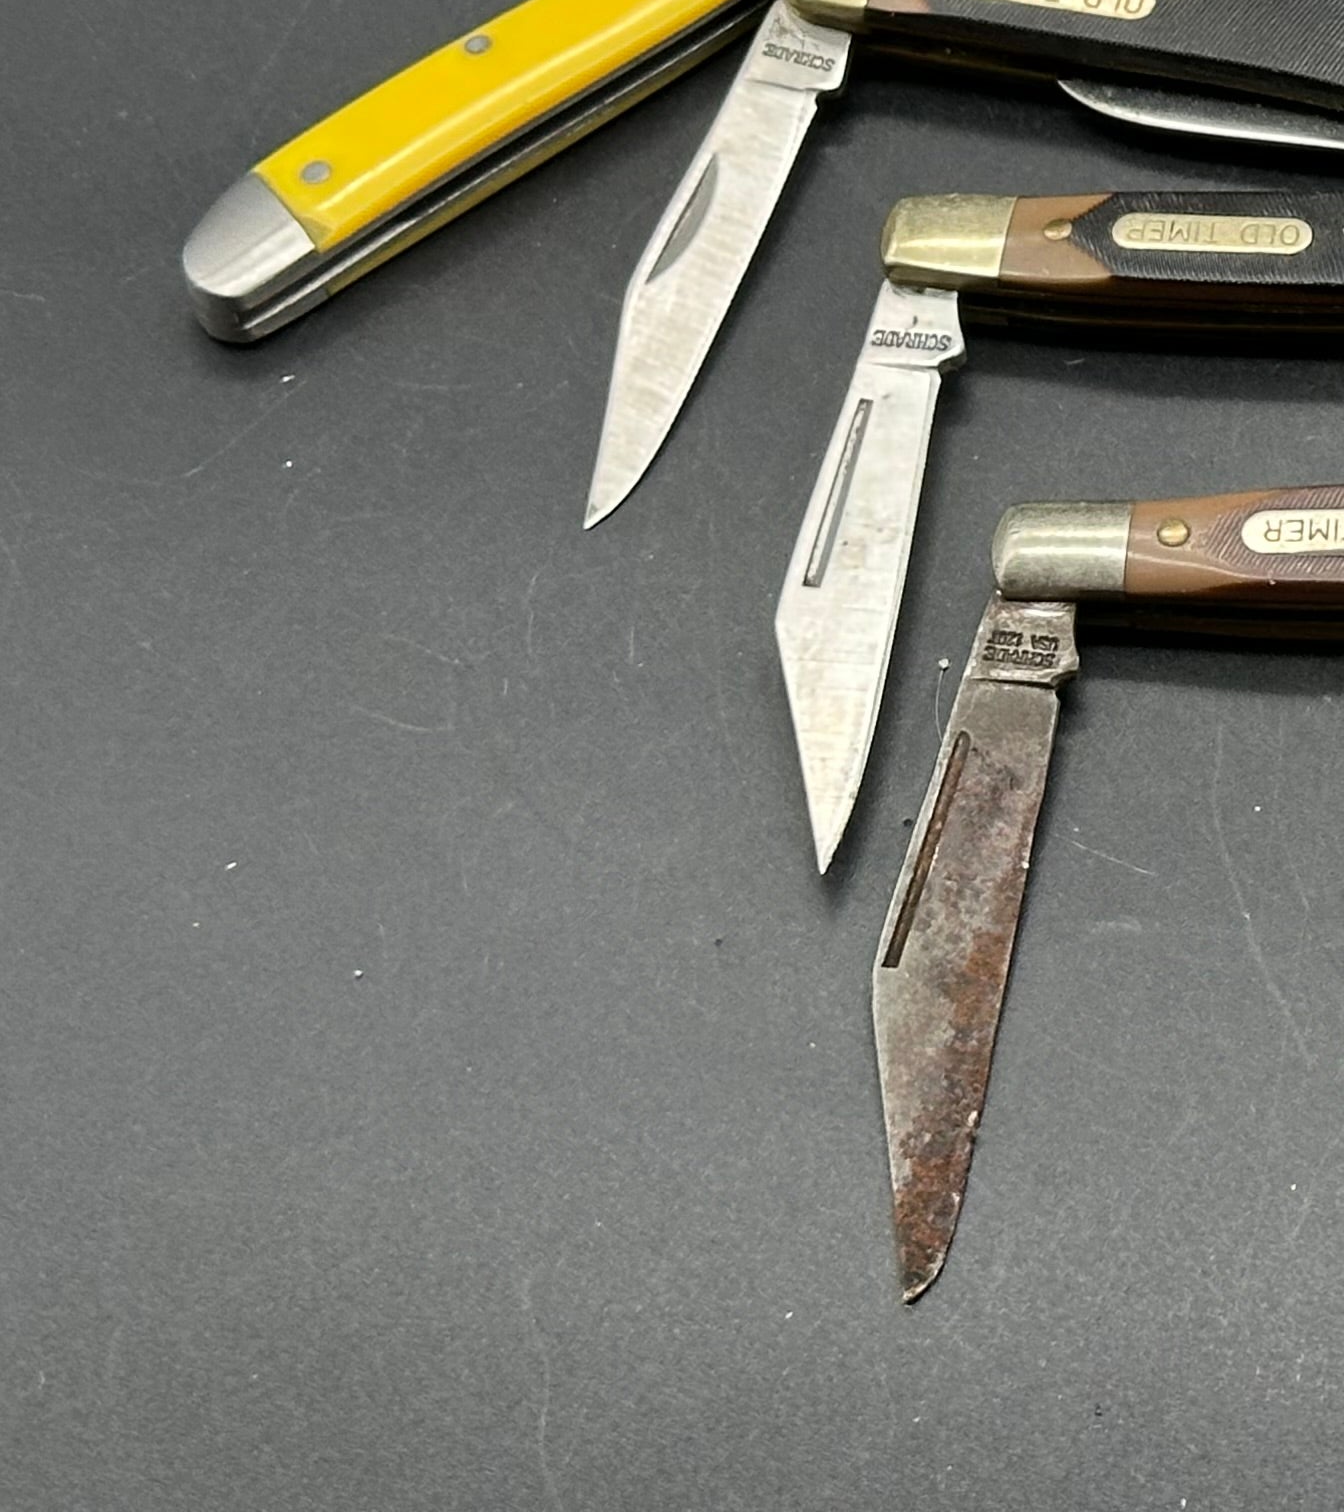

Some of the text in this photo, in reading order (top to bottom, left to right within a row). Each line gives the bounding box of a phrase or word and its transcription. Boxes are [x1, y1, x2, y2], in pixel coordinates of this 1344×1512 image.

[1126, 219, 1301, 246] OLD TIMER
[870, 329, 952, 351] SCHRADE
